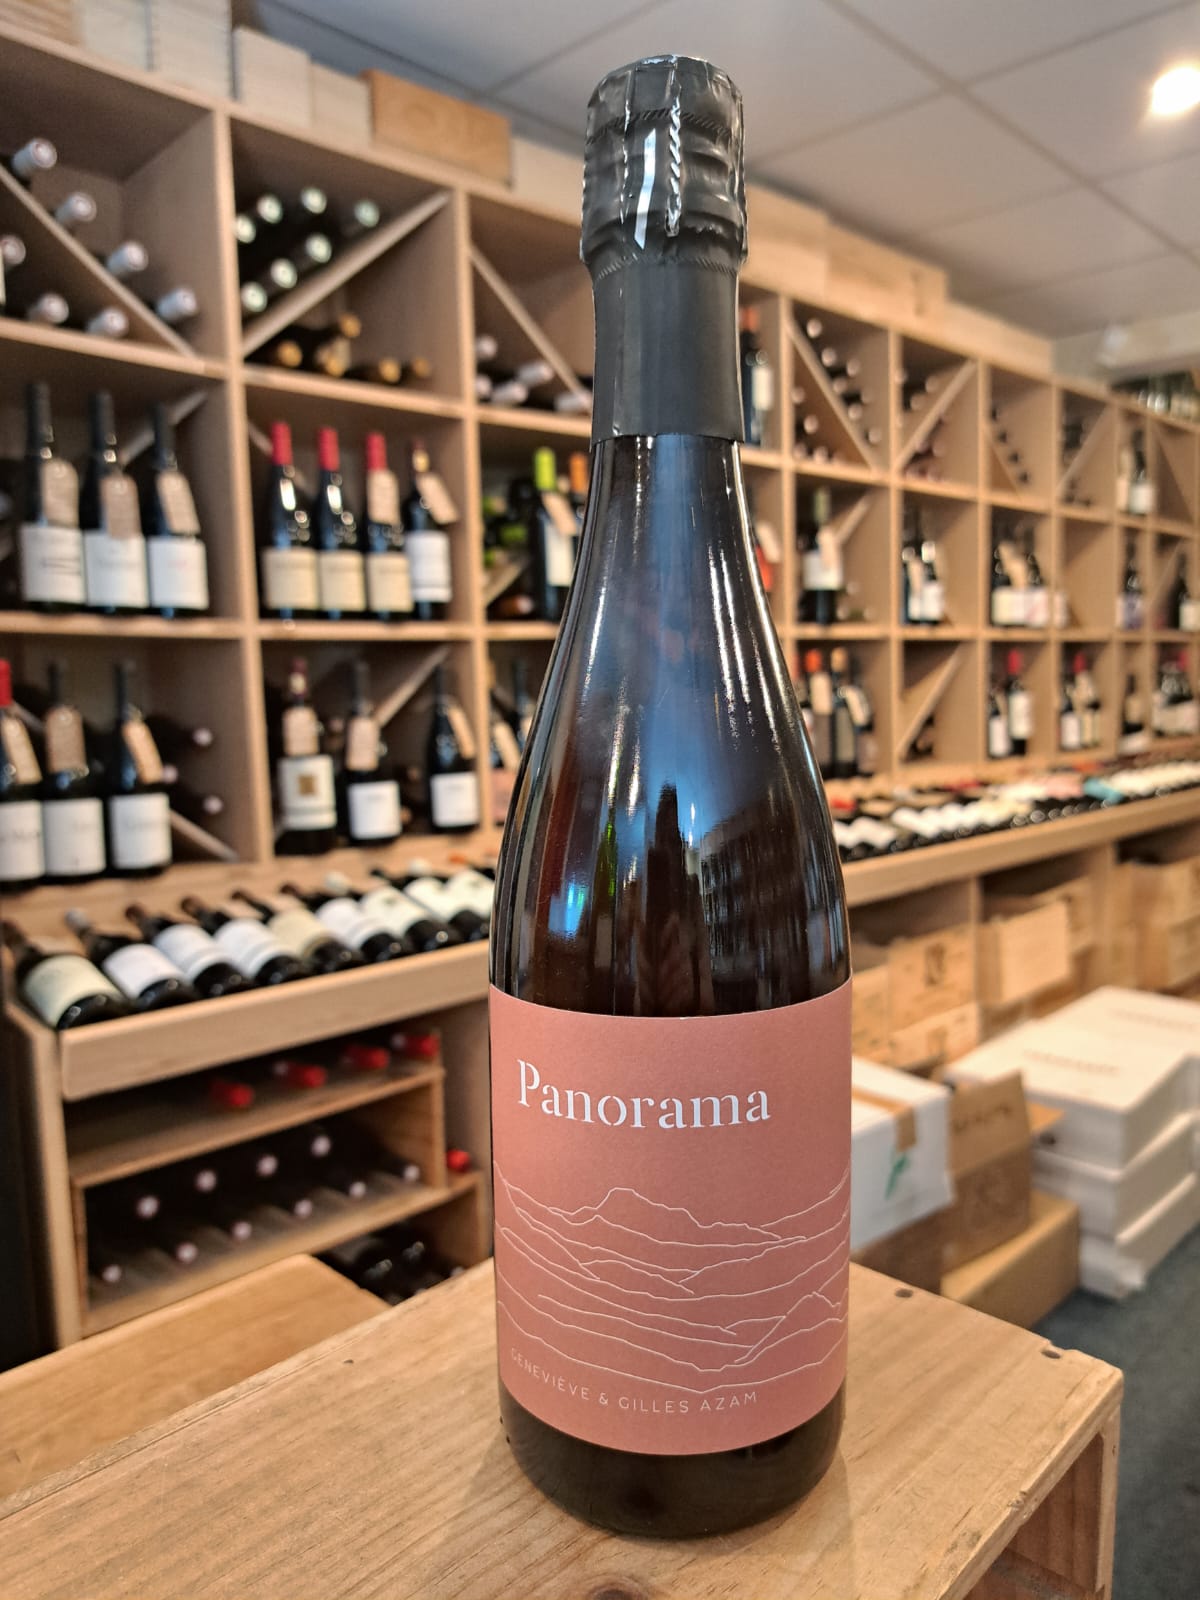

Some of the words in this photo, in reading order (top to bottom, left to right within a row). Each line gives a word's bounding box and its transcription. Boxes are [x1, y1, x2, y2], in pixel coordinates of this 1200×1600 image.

[517, 1059, 771, 1129] Panorama
[511, 1347, 590, 1401] GENEVIÈVE
[598, 1392, 609, 1405] &
[618, 1396, 689, 1413] GILLES
[699, 1391, 757, 1412] AZAM
